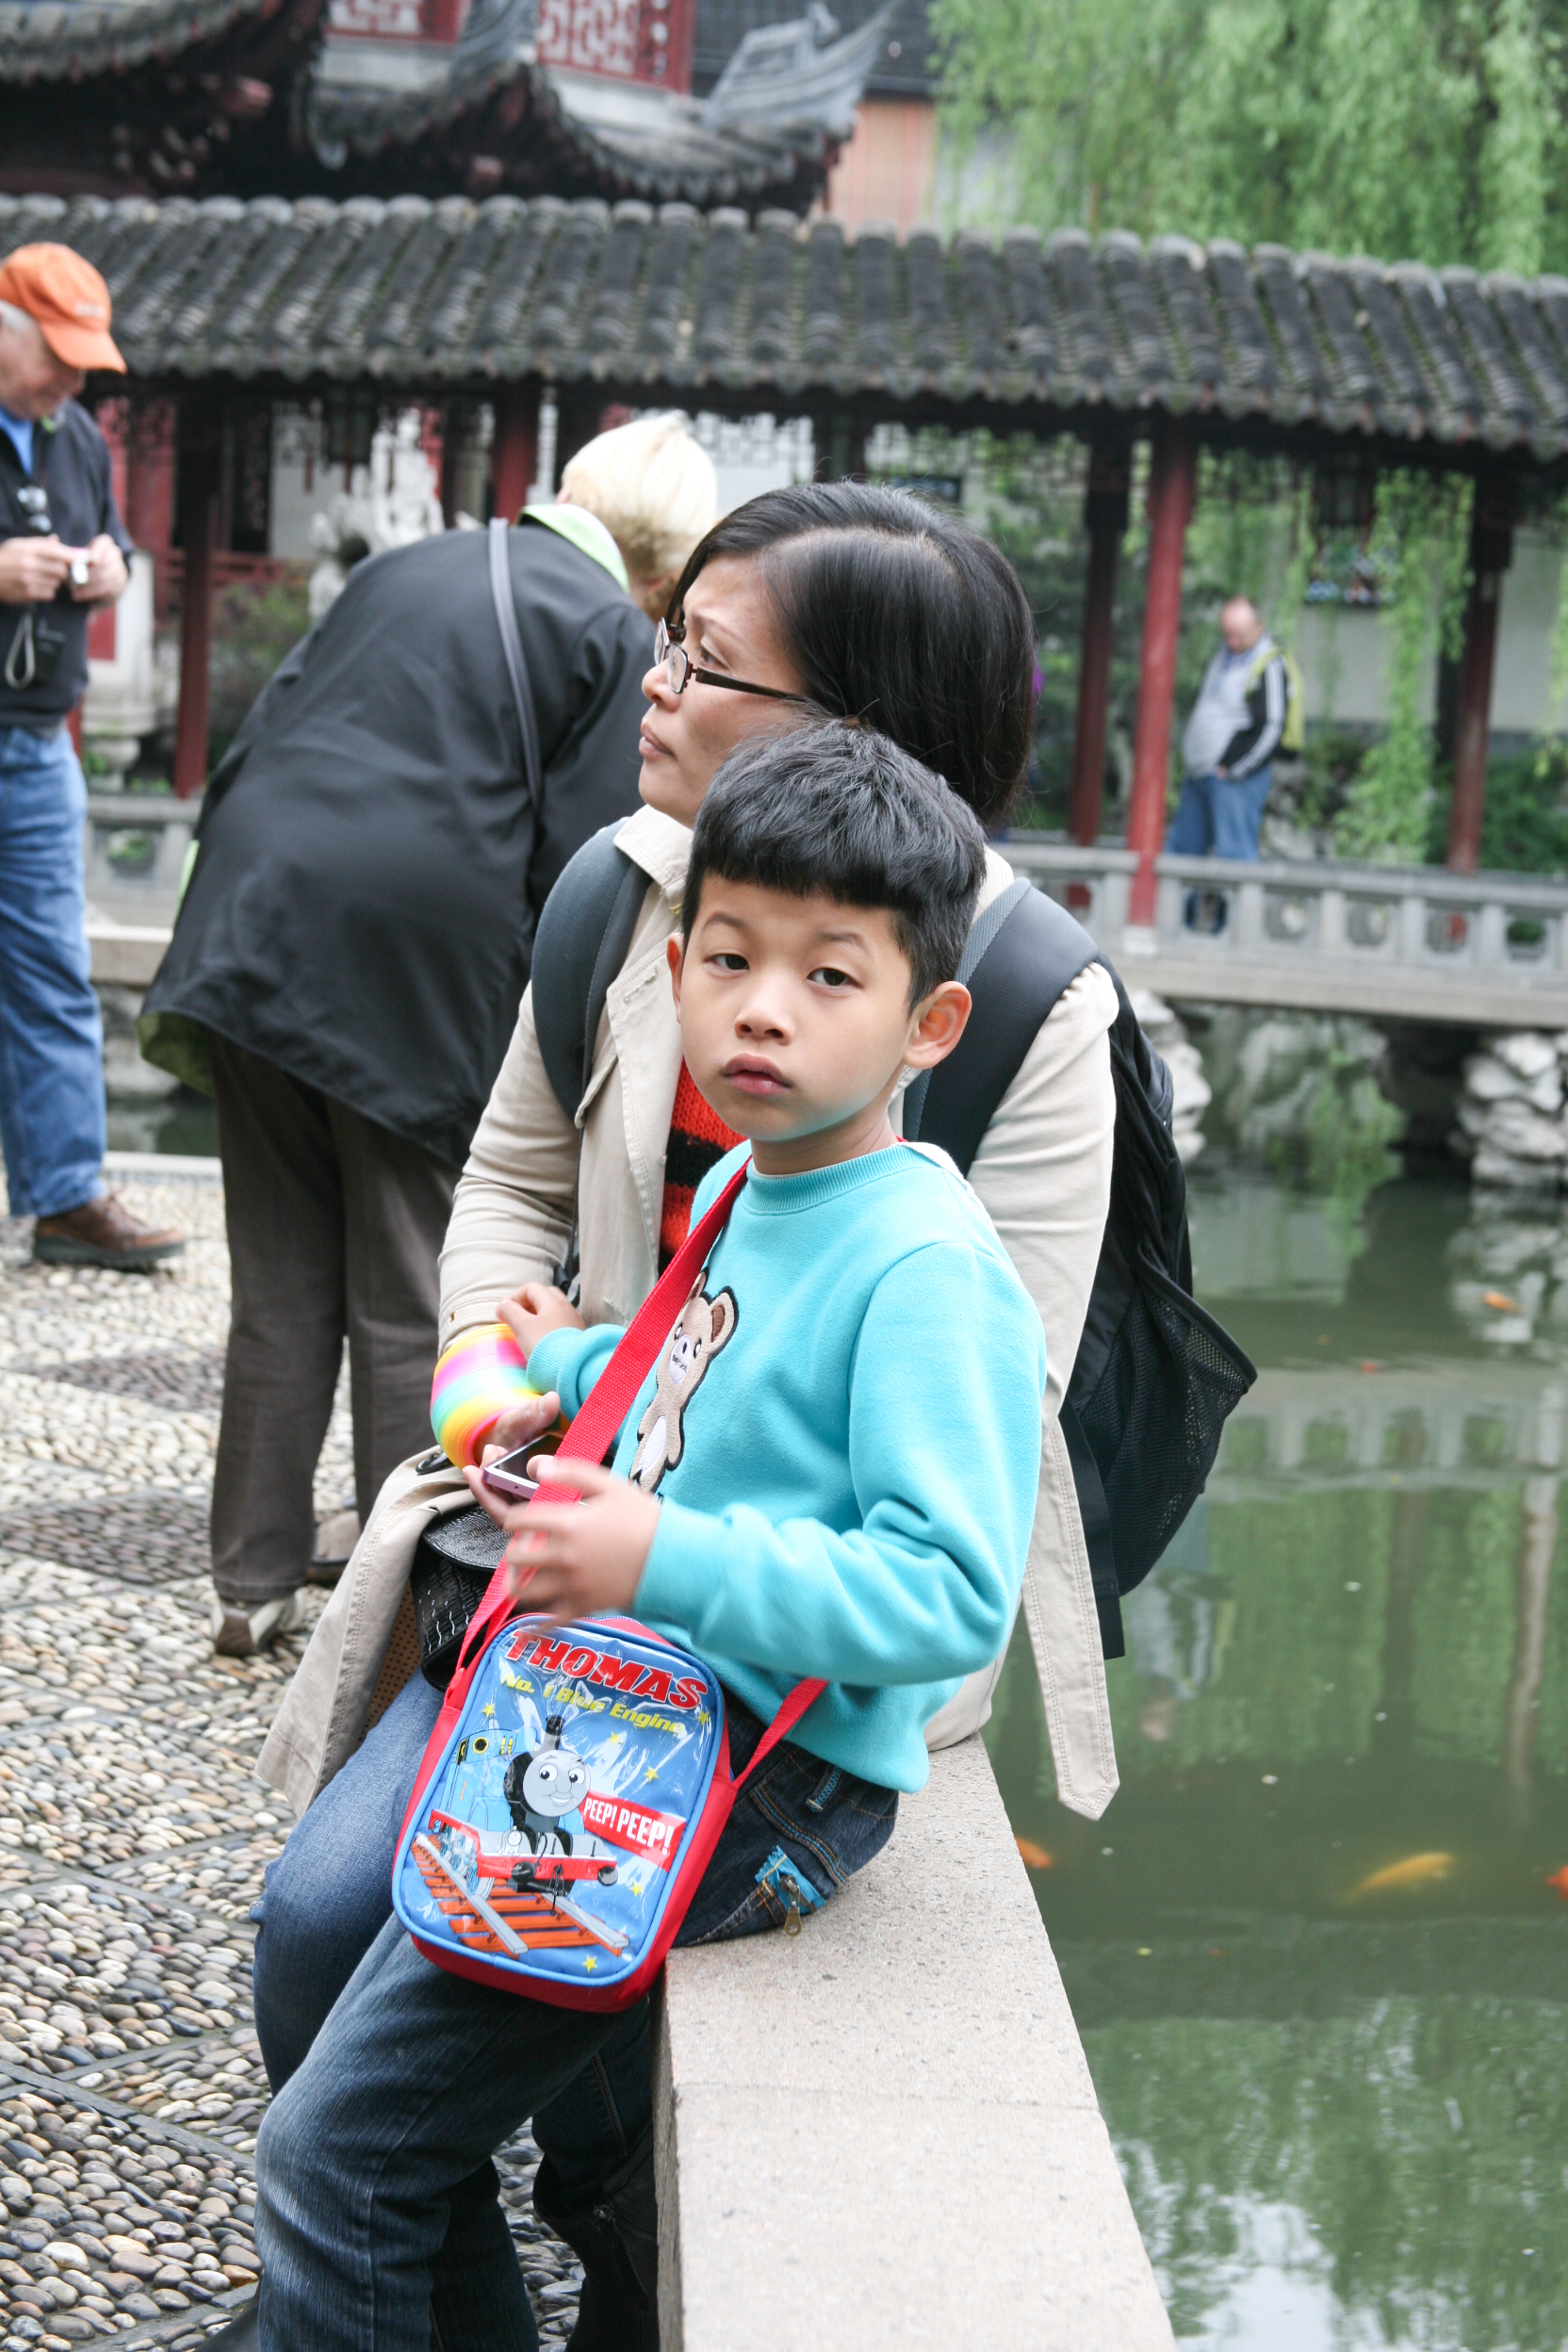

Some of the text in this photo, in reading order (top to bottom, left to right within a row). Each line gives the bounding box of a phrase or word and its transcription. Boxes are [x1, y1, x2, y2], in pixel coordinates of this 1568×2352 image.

[504, 1631, 708, 1709] THOMAS
[501, 1674, 685, 1734] No. 1 Blue Engine
[583, 1797, 675, 1855] PEEP! PEEP!
